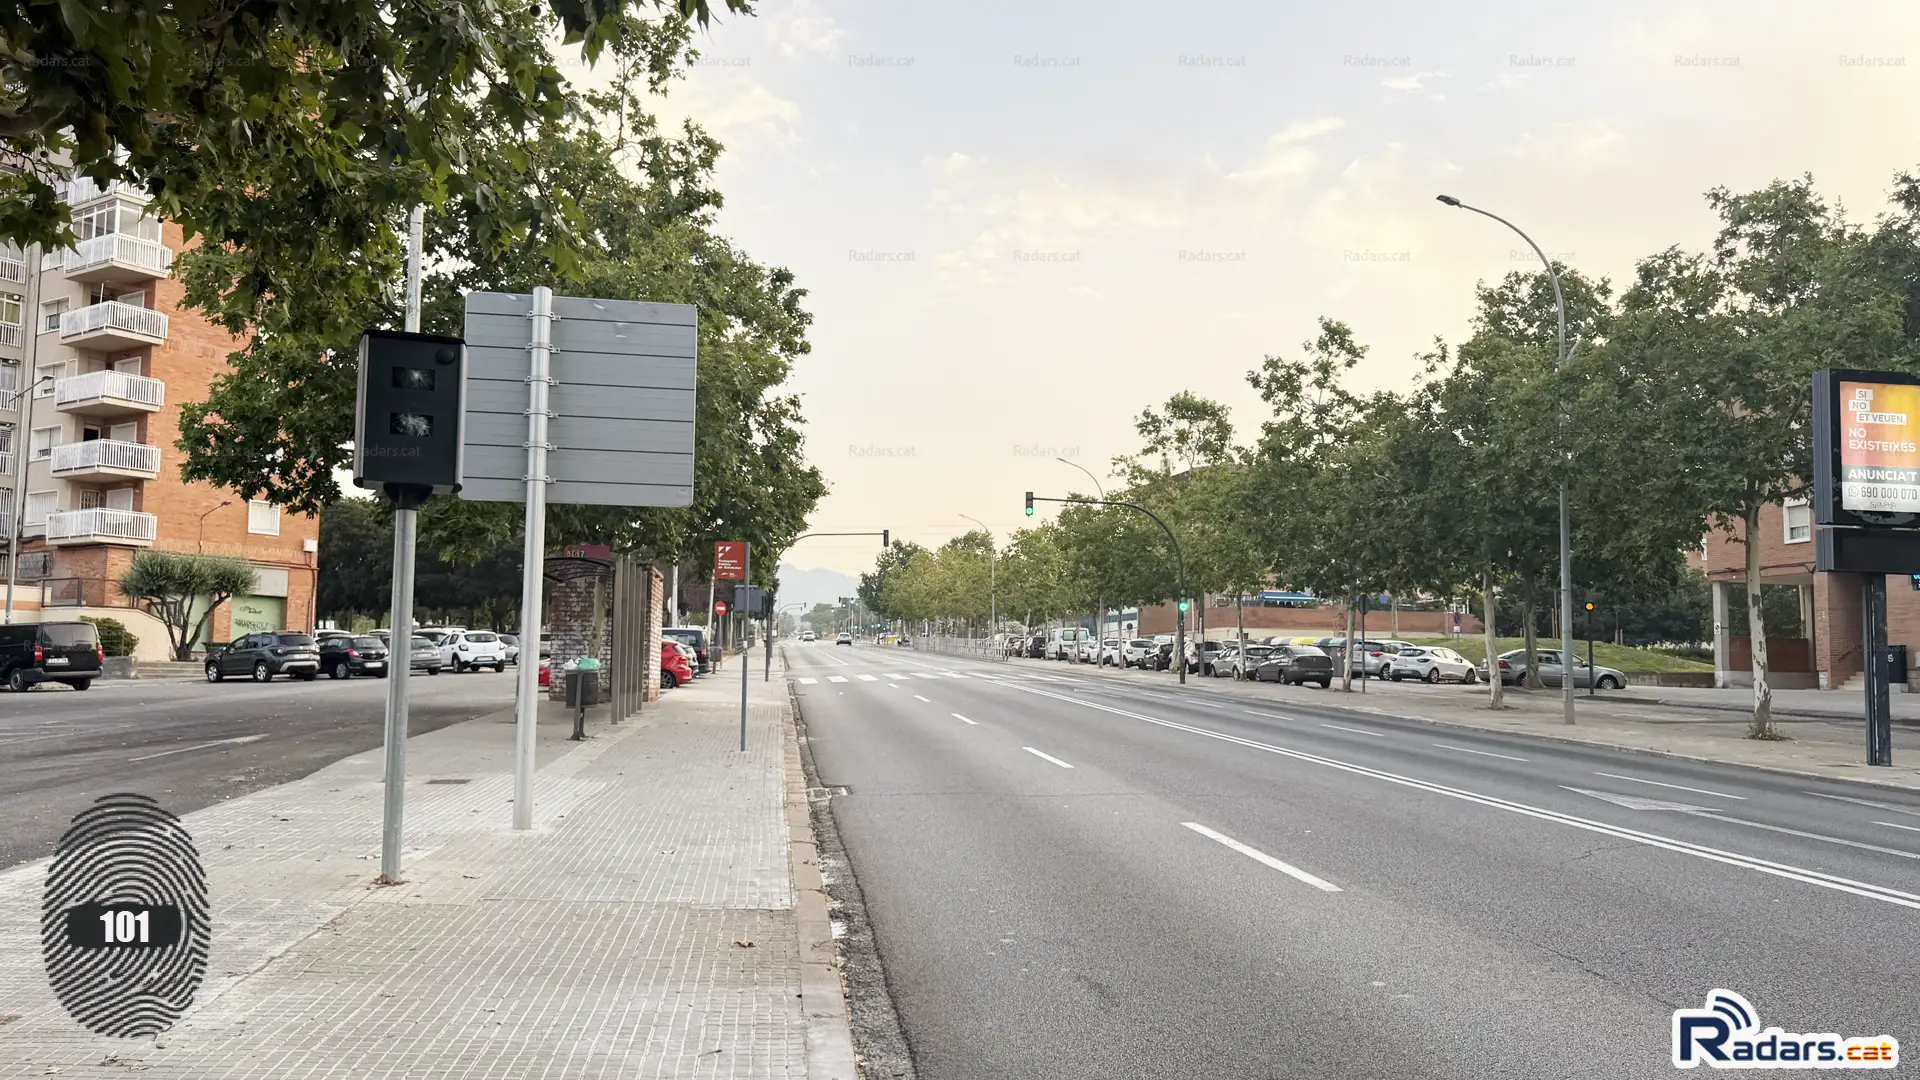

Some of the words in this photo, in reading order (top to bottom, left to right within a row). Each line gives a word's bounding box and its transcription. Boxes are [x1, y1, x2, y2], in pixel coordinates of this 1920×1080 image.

[1858, 390, 1867, 398] SI
[1852, 401, 1867, 410] NO
[1859, 413, 1870, 421] ET
[1872, 414, 1906, 424] VEUEN.
[1849, 428, 1866, 437] NO
[1849, 440, 1916, 452] EXISTEIXES
[1848, 469, 1917, 481] ANUNCIA'T
[1860, 486, 1878, 499] 690
[1880, 487, 1898, 500] 000
[1900, 488, 1918, 501] 070
